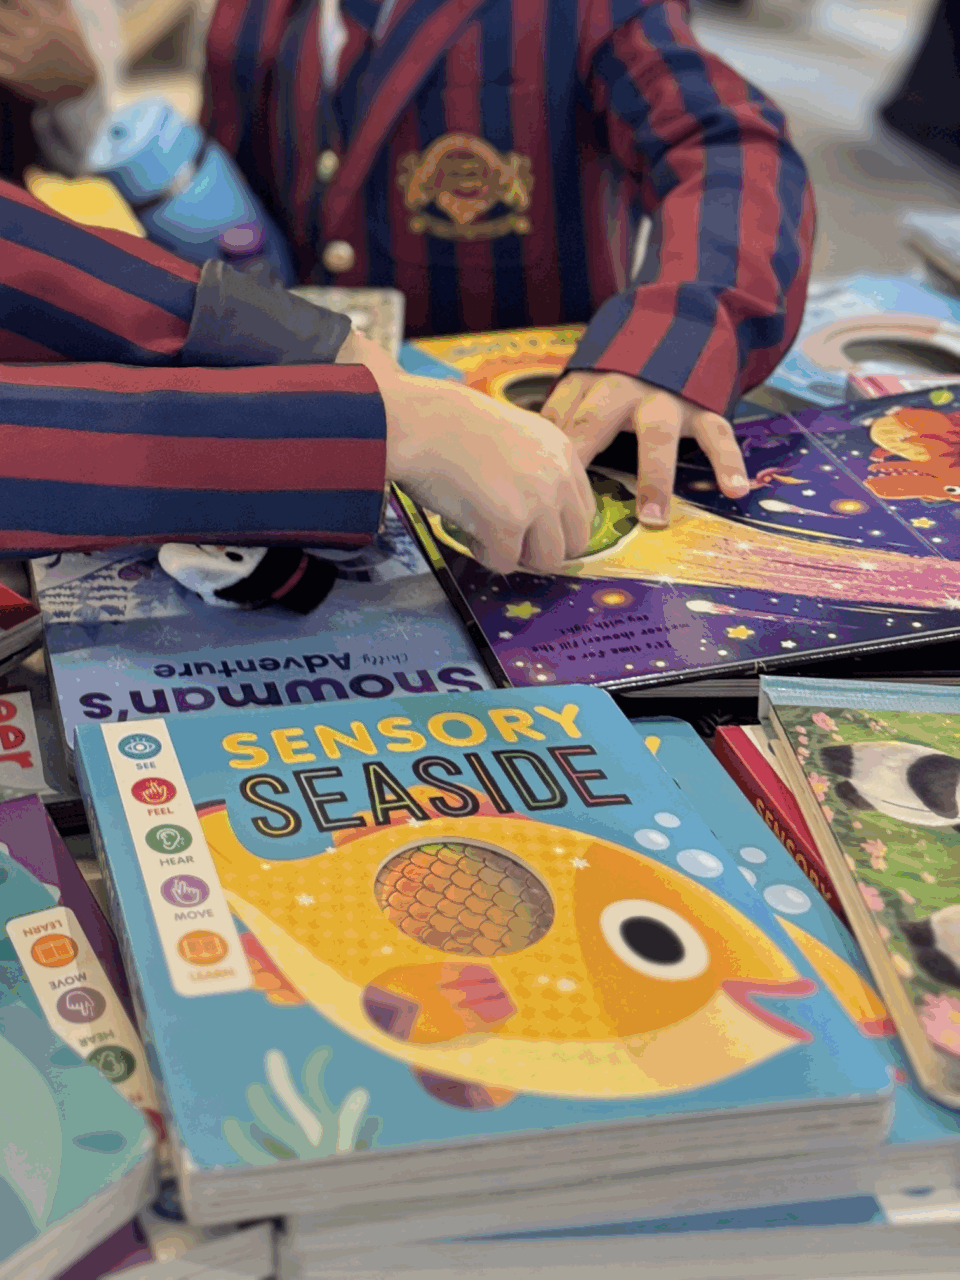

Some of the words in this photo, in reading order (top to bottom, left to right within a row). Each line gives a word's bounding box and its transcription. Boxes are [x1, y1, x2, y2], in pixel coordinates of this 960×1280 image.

[153, 652, 352, 679] Adventure
[78, 666, 484, 723] Snowman's
[221, 703, 584, 770] SENSORY
[135, 761, 157, 771] SEE
[239, 743, 633, 839] SEASIDE
[146, 806, 175, 817] FEEL
[159, 854, 195, 867] HEAR
[174, 908, 215, 922] MOVE
[22, 918, 64, 938] LEARN
[48, 971, 88, 991] MOVE
[78, 1028, 116, 1048] HEAR
